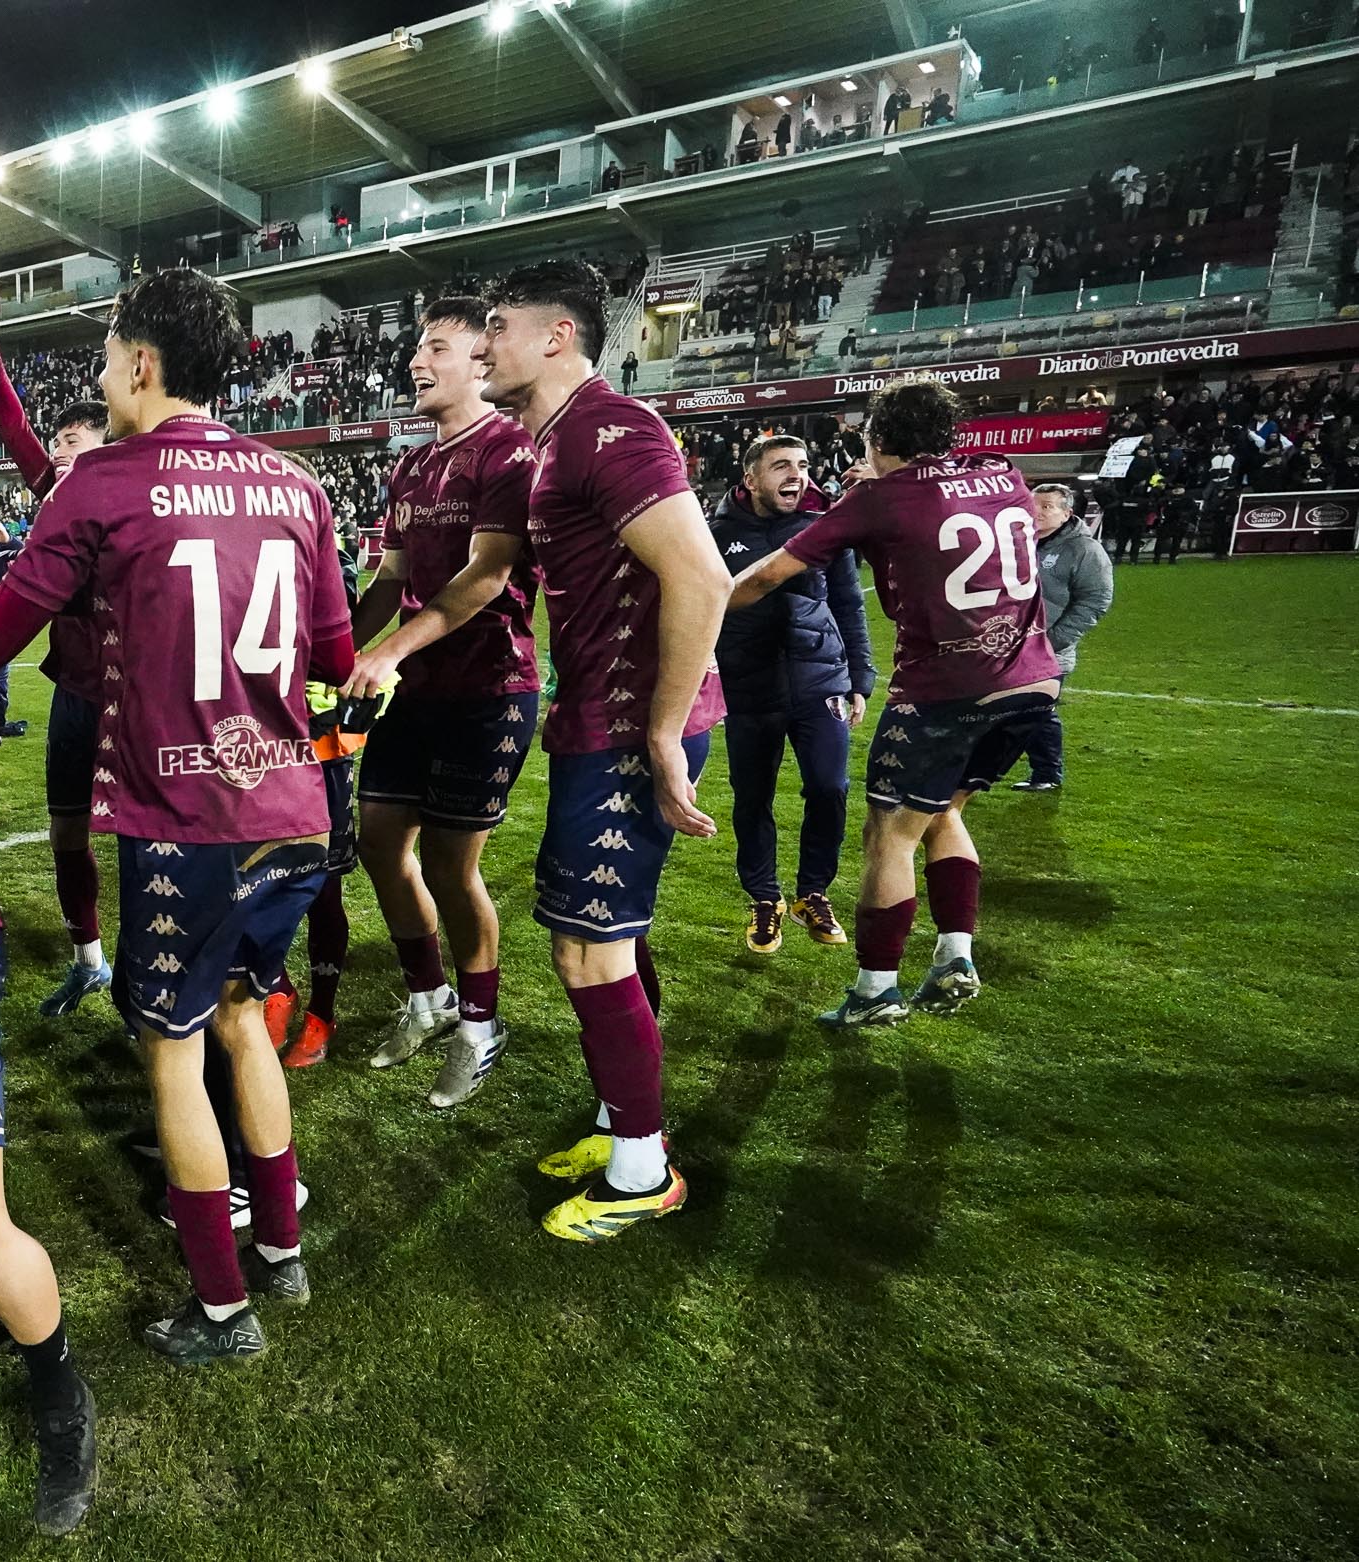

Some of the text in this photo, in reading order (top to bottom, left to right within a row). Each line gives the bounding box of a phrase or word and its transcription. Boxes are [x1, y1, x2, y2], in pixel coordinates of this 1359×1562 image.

[1121, 339, 1240, 367] Pontevedra
[676, 393, 745, 409] PESCAMAR
[342, 427, 373, 436] RAMÍREZ
[403, 421, 436, 431] RAMÍREZ
[985, 430, 1006, 446] DEL
[1010, 428, 1034, 444] REY
[1042, 427, 1103, 438] MAPFRE
[938, 475, 1015, 499] PELAYO
[150, 484, 314, 521] SAMU MAYO
[631, 493, 659, 514] VOLTAR
[938, 507, 1038, 611] 20
[167, 539, 298, 701] 14
[158, 739, 321, 776] PESCAMAR
